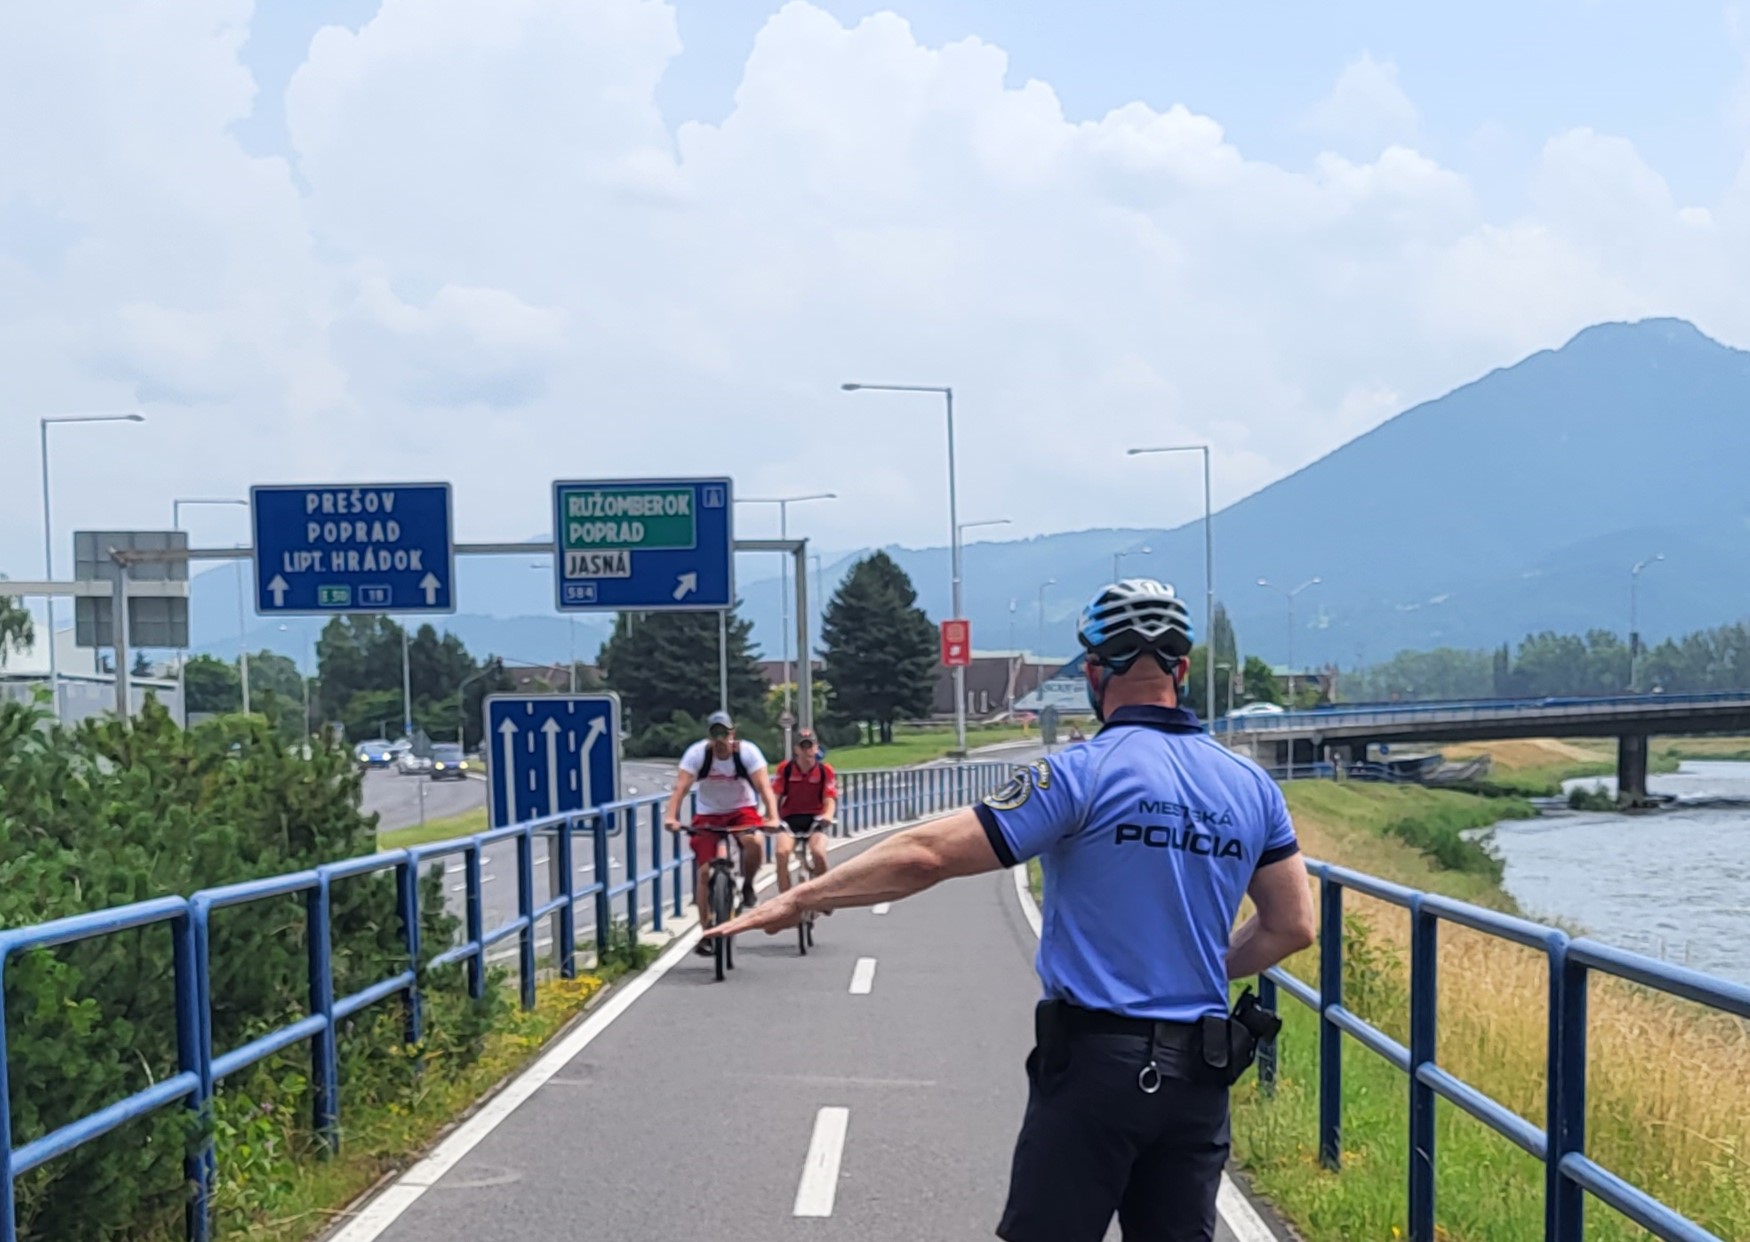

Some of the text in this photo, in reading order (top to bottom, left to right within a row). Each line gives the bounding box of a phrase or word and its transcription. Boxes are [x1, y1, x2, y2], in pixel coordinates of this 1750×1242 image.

[306, 489, 396, 515] PREŠOV
[568, 490, 690, 517] RUŽOMBEROK
[307, 521, 401, 544] POPRAD
[569, 521, 645, 544] POPRAD
[283, 546, 424, 573] LIPT. HRÁDOK
[569, 550, 627, 576] JASNÁ
[1115, 822, 1243, 861] POLÍCIA
